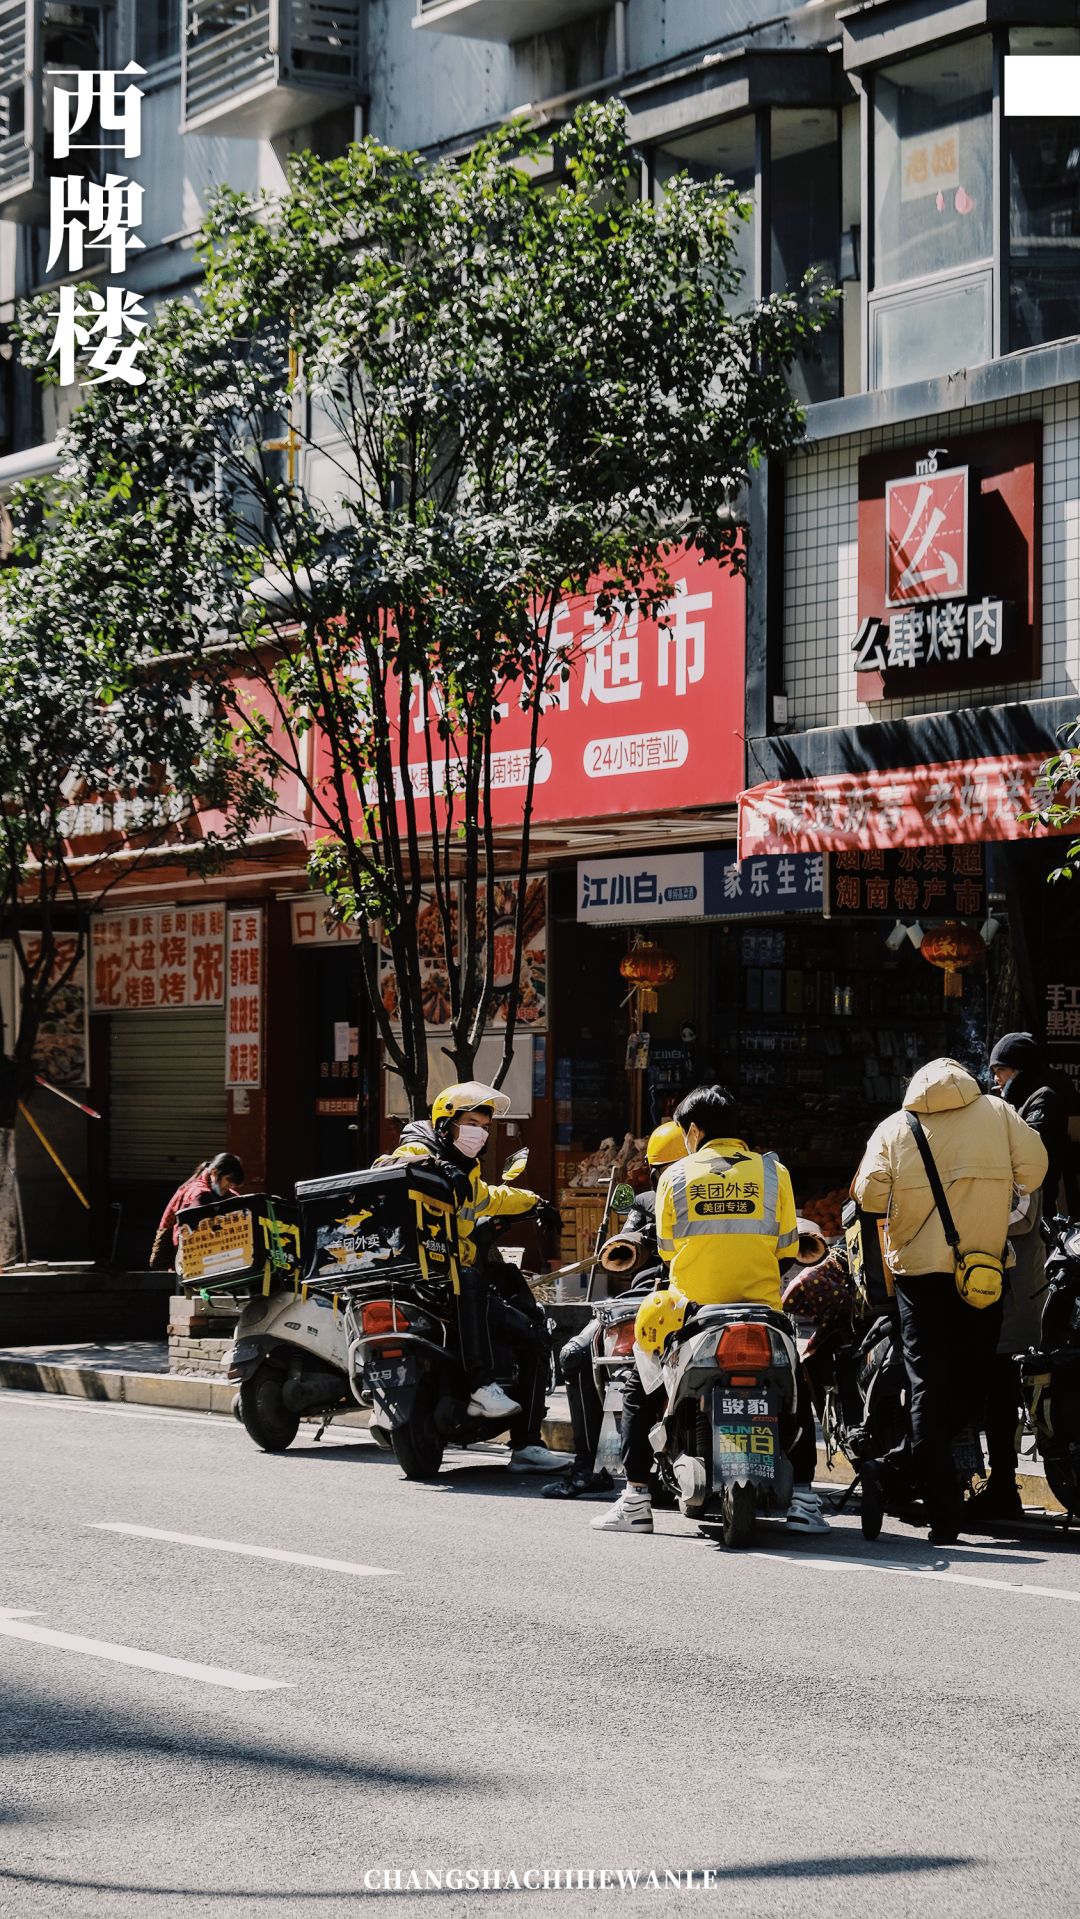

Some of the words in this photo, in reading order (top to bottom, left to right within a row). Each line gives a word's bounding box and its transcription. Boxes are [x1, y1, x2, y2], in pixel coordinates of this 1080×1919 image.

[593, 734, 679, 771] 24小时营业
[581, 872, 658, 909] 江小白
[836, 876, 947, 910] 湖南特产
[690, 1182, 759, 1201] 美团外卖
[702, 1202, 748, 1213] 美团专送
[722, 1398, 769, 1415] 骏豹
[719, 1425, 773, 1436] SUNRA
[720, 1434, 774, 1455] 新日
